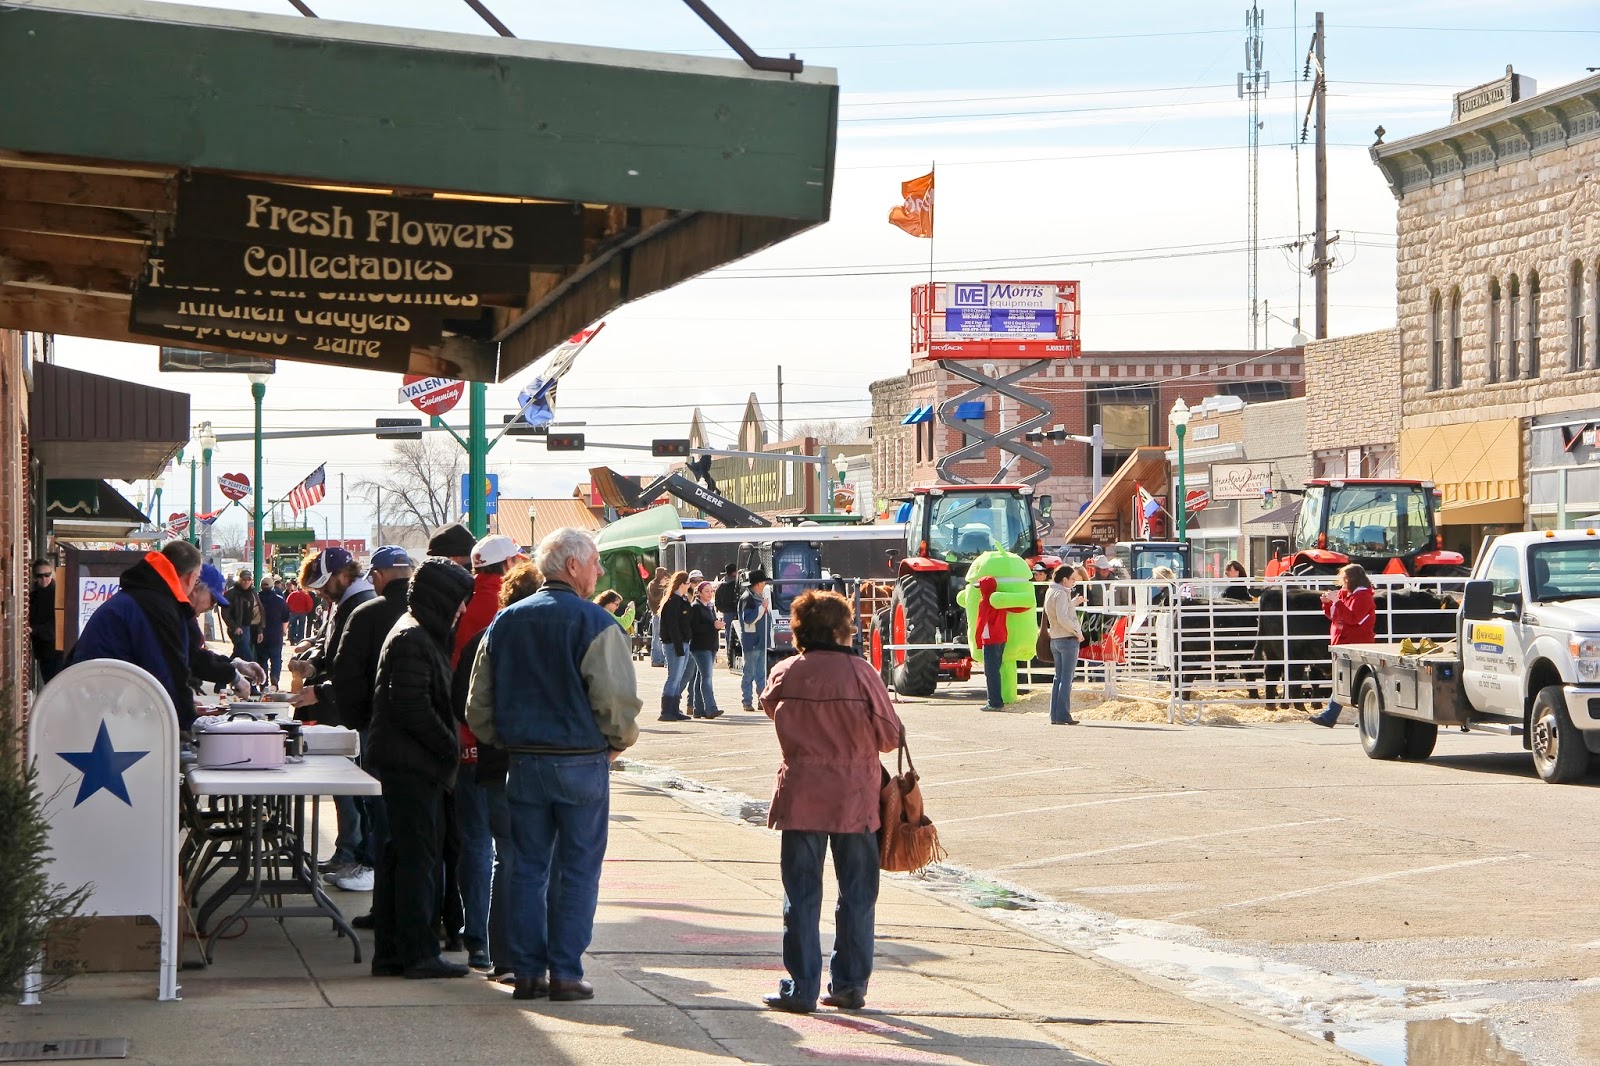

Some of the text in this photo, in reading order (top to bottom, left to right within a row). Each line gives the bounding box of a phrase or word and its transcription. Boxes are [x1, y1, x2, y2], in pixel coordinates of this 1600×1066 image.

[247, 194, 515, 250] Fresh Flowers
[960, 284, 1043, 302] ME Morris
[989, 300, 1043, 308] equipment
[931, 343, 963, 352] SKYJACK
[403, 377, 456, 398] VALENT
[420, 389, 459, 409] Swimming
[695, 488, 724, 508] DEERE
[1092, 526, 1106, 535] Auntie
[83, 580, 119, 601] BAK
[1488, 632, 1502, 641] HOLLAND
